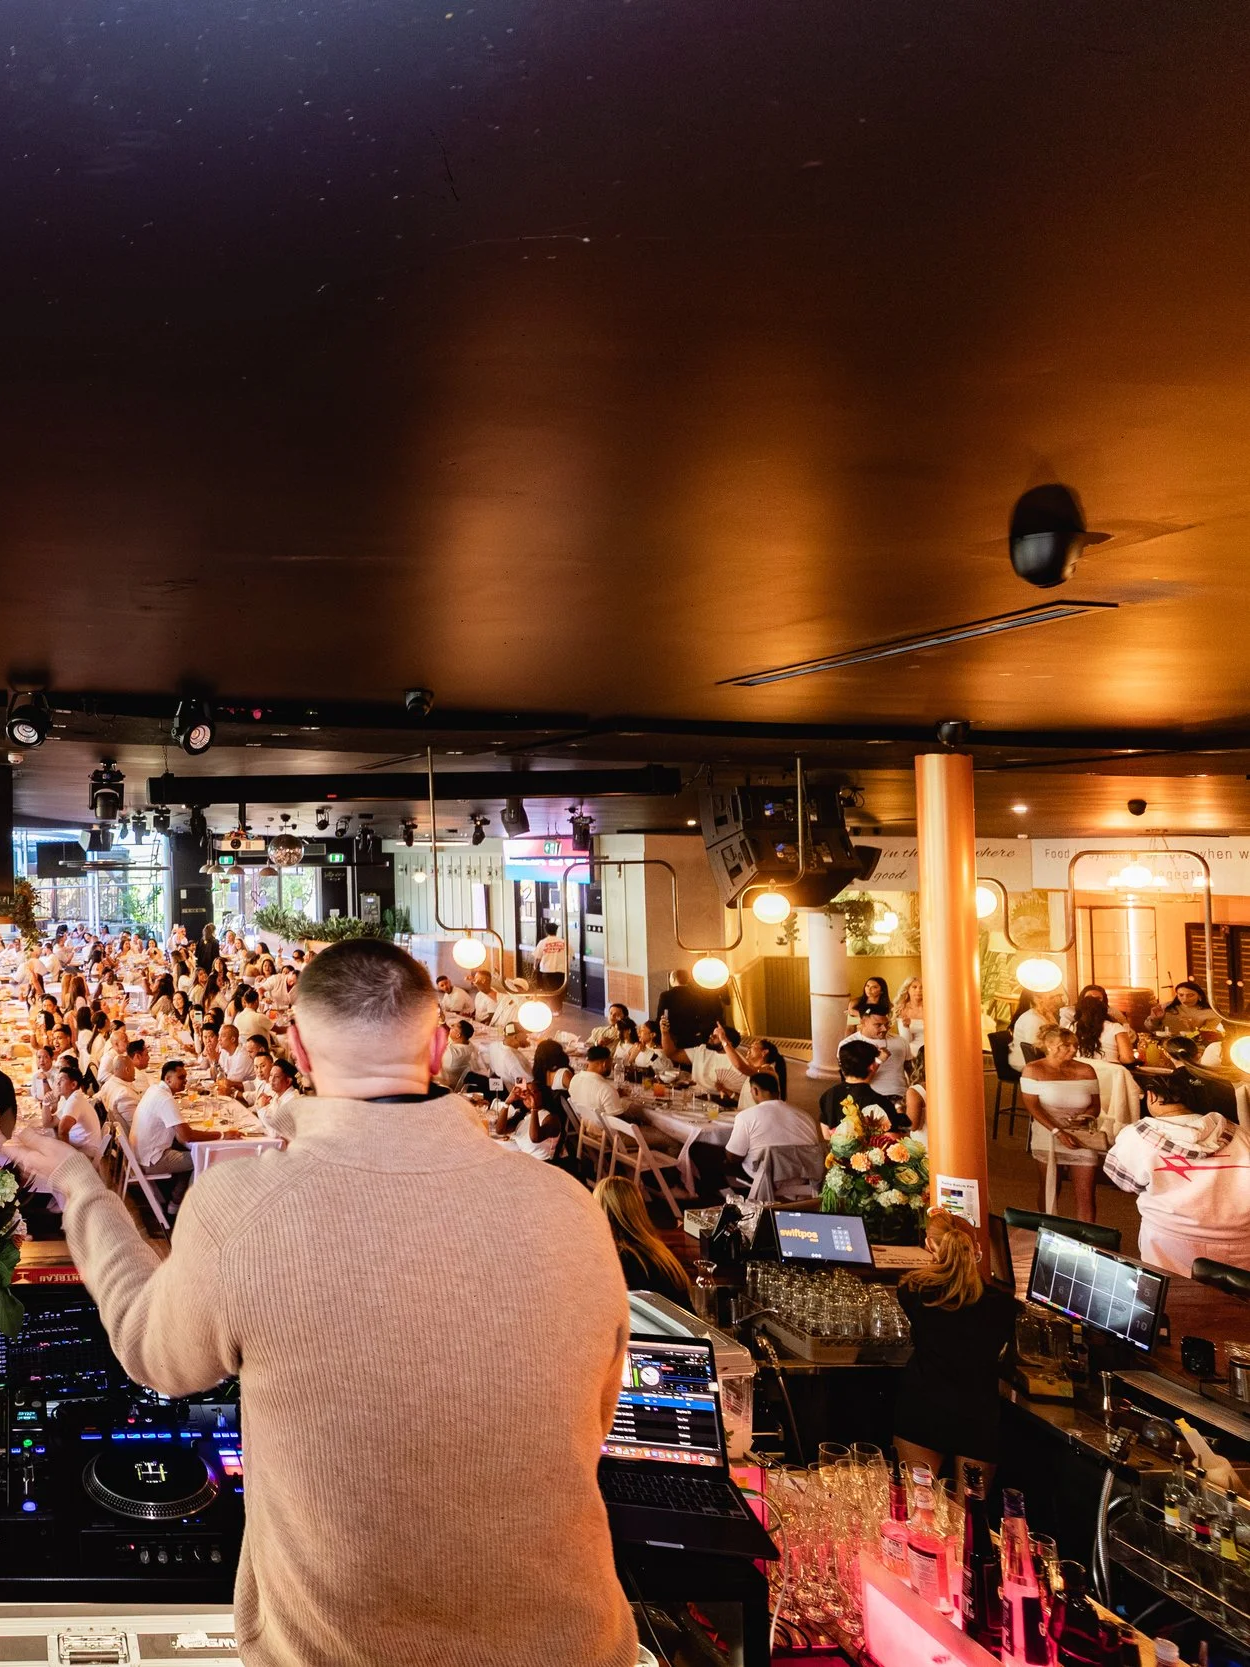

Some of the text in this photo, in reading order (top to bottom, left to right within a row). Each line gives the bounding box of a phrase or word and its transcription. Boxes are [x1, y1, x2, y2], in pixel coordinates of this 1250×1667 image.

[883, 849, 899, 858] in
[902, 847, 918, 858] th
[1045, 848, 1070, 859] Food
[1200, 848, 1233, 860] when
[873, 870, 907, 882] good
[1058, 1285, 1065, 1295] 6
[1144, 1288, 1151, 1297] 5
[1135, 1319, 1148, 1331] 10
